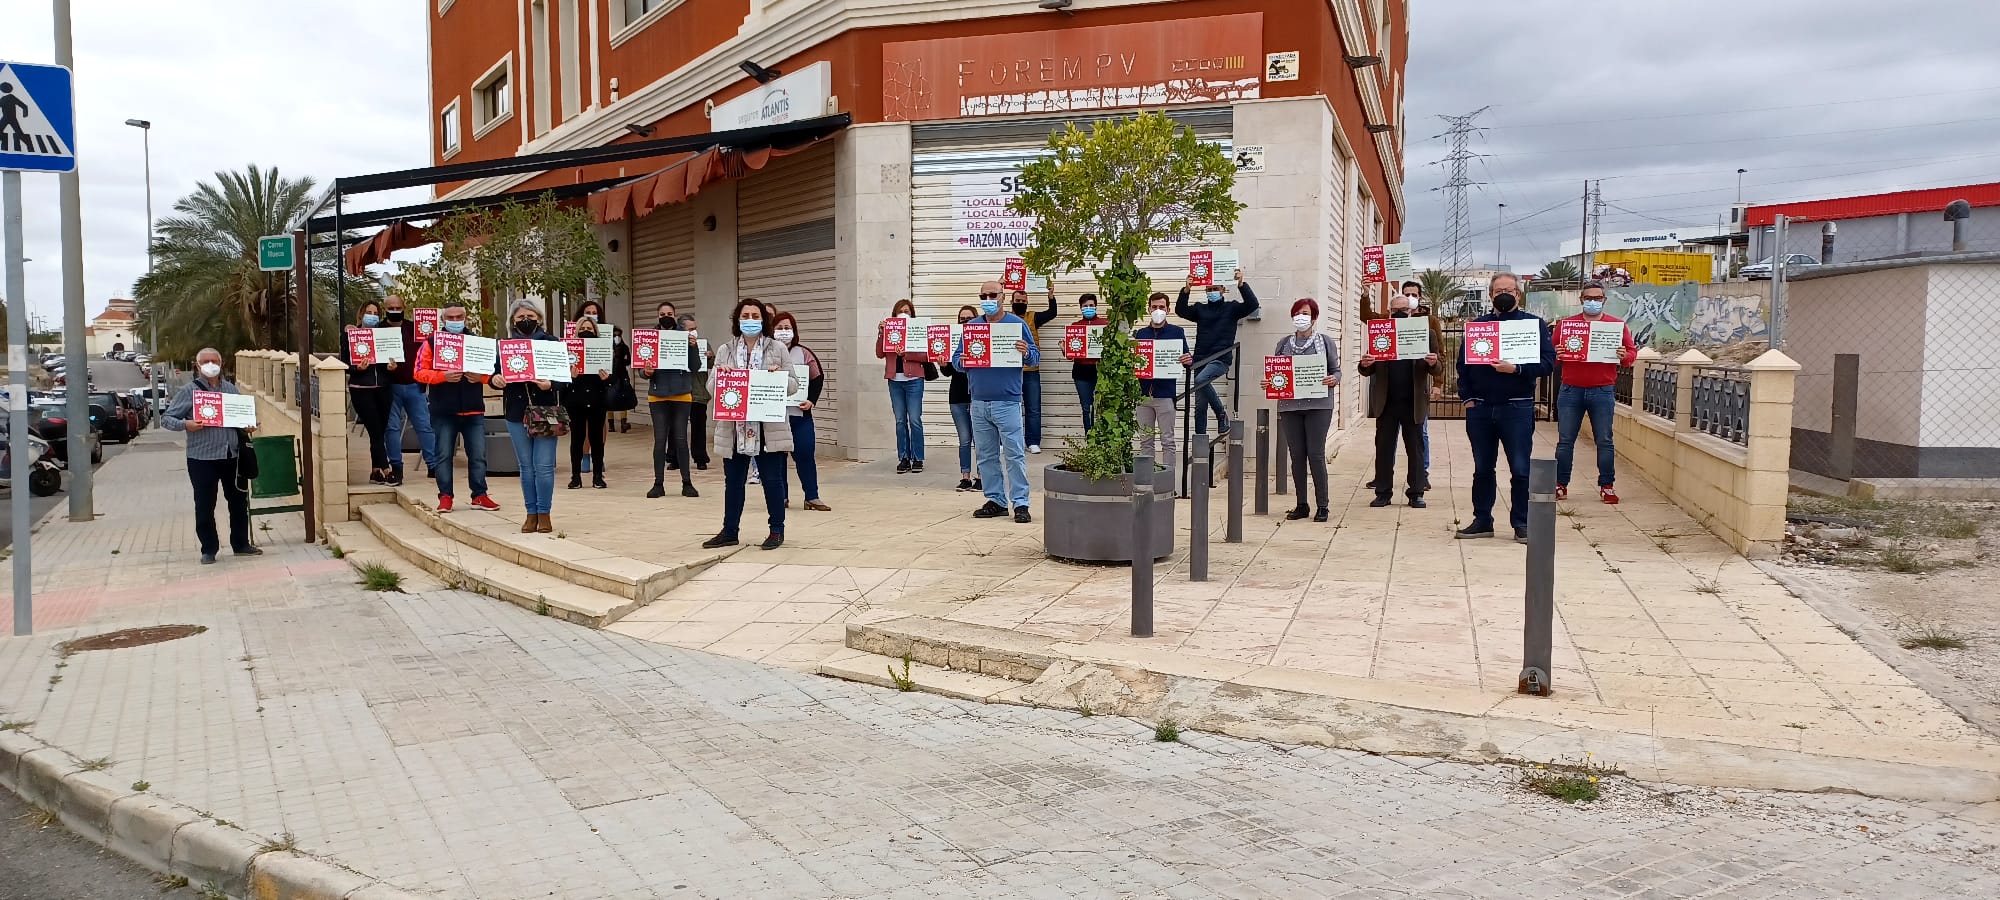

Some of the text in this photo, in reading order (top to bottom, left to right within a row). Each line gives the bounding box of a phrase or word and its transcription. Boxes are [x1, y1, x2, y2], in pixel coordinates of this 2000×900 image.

[957, 50, 1137, 88] FOREM PV
[761, 97, 789, 121] ATLANTIS
[967, 220, 1032, 230] DE 200, 400,
[969, 229, 1027, 248] RAZÓN AQUÍ
[1266, 364, 1273, 372] SÍ
[717, 377, 726, 388] SÍ
